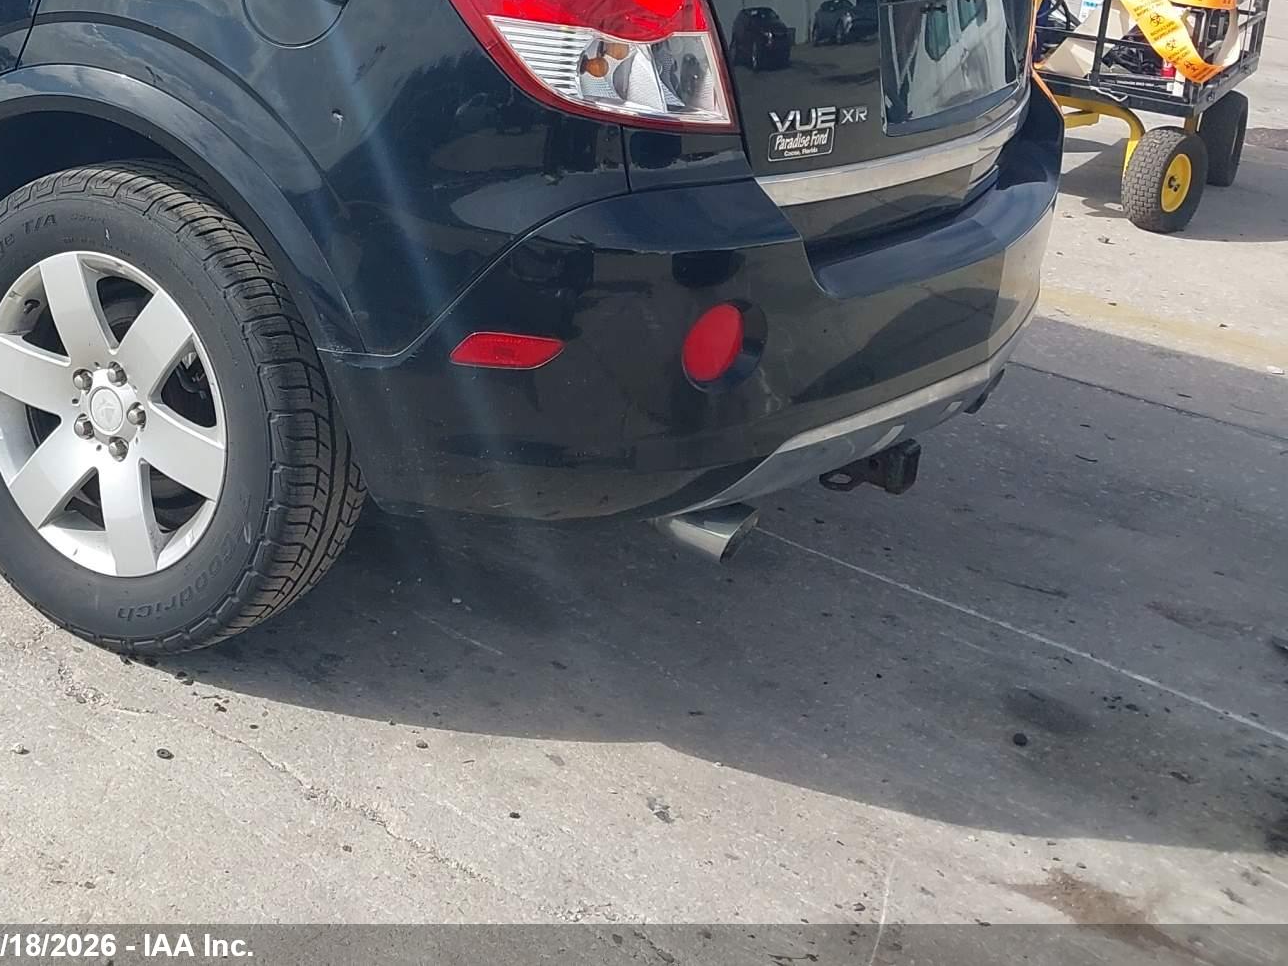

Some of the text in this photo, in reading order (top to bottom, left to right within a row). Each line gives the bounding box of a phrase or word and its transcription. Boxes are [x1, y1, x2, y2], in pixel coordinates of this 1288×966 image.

[769, 106, 869, 132] VUE XR
[774, 128, 830, 151] Paradise Ford
[22, 213, 58, 235] T/A
